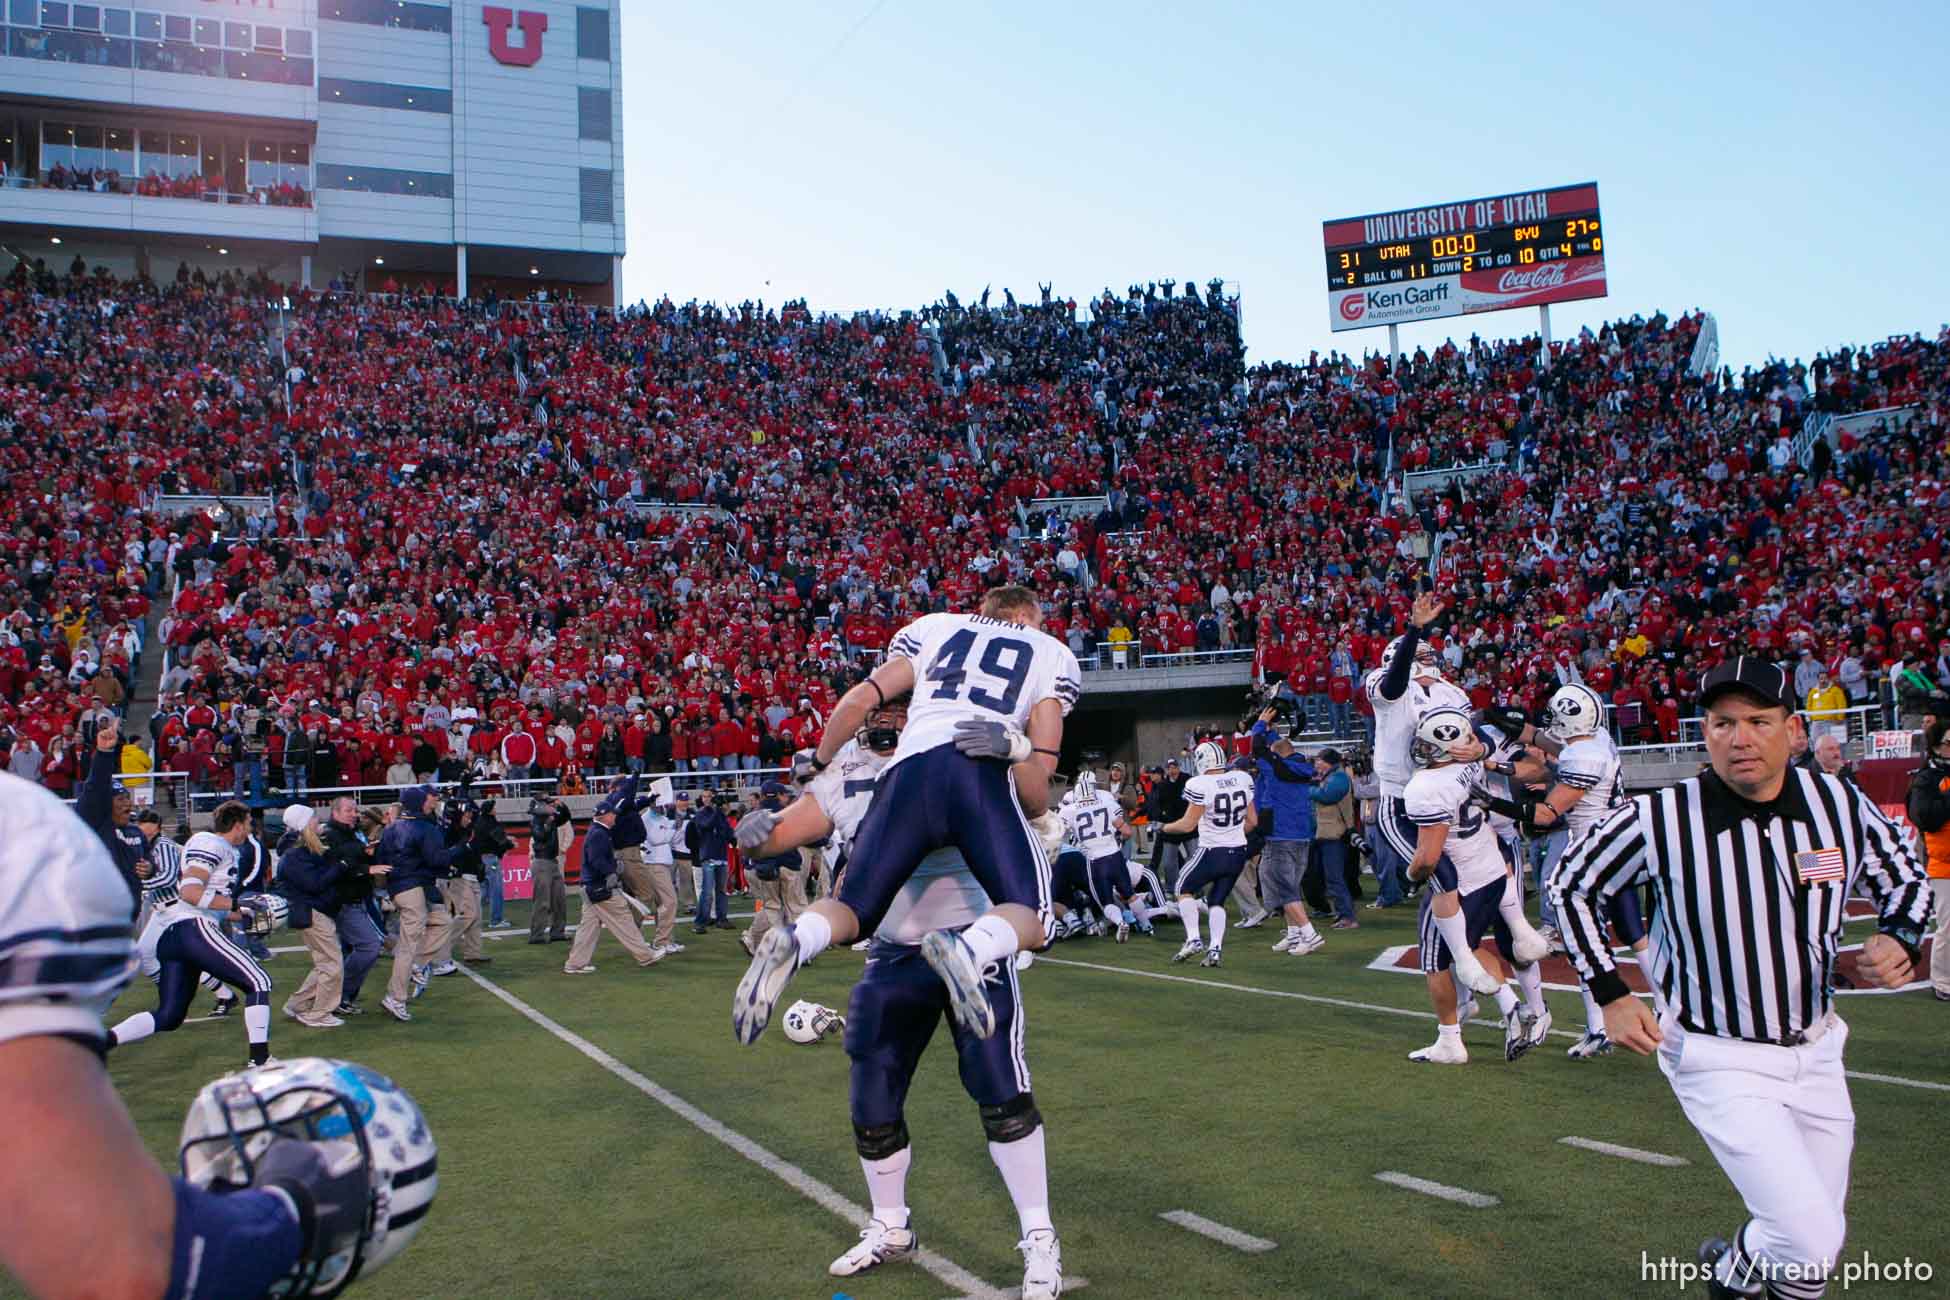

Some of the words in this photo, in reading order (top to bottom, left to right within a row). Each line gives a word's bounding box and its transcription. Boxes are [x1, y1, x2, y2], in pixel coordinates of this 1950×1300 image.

[482, 6, 548, 67] U
[1364, 204, 1467, 244] UNIVERSITY
[1475, 200, 1496, 229] OF
[1503, 192, 1548, 223] UTAH
[1566, 220, 1587, 237] 27
[1514, 225, 1540, 241] BYU
[1340, 252, 1360, 269] 31
[1347, 273, 1355, 285] 2
[1364, 271, 1387, 283] BALL
[1390, 269, 1403, 280] ON
[1410, 263, 1425, 279] 11
[1432, 261, 1461, 274] DOWN
[1463, 257, 1473, 272] 2
[1479, 256, 1493, 267] TO
[1497, 253, 1511, 265] GO
[1519, 247, 1535, 264] 10
[1539, 247, 1559, 260] QTR
[1560, 243, 1571, 257] 4
[1592, 237, 1602, 251] 0
[1379, 245, 1411, 260] UTAH
[1368, 289, 1402, 309] Ken
[1405, 282, 1448, 305] Garff
[1368, 307, 1413, 321] Automotive
[1415, 303, 1441, 315] Group
[926, 628, 1034, 716] 49
[1212, 790, 1248, 828] 92
[1075, 808, 1111, 842] 27
[502, 868, 533, 883] UTA
